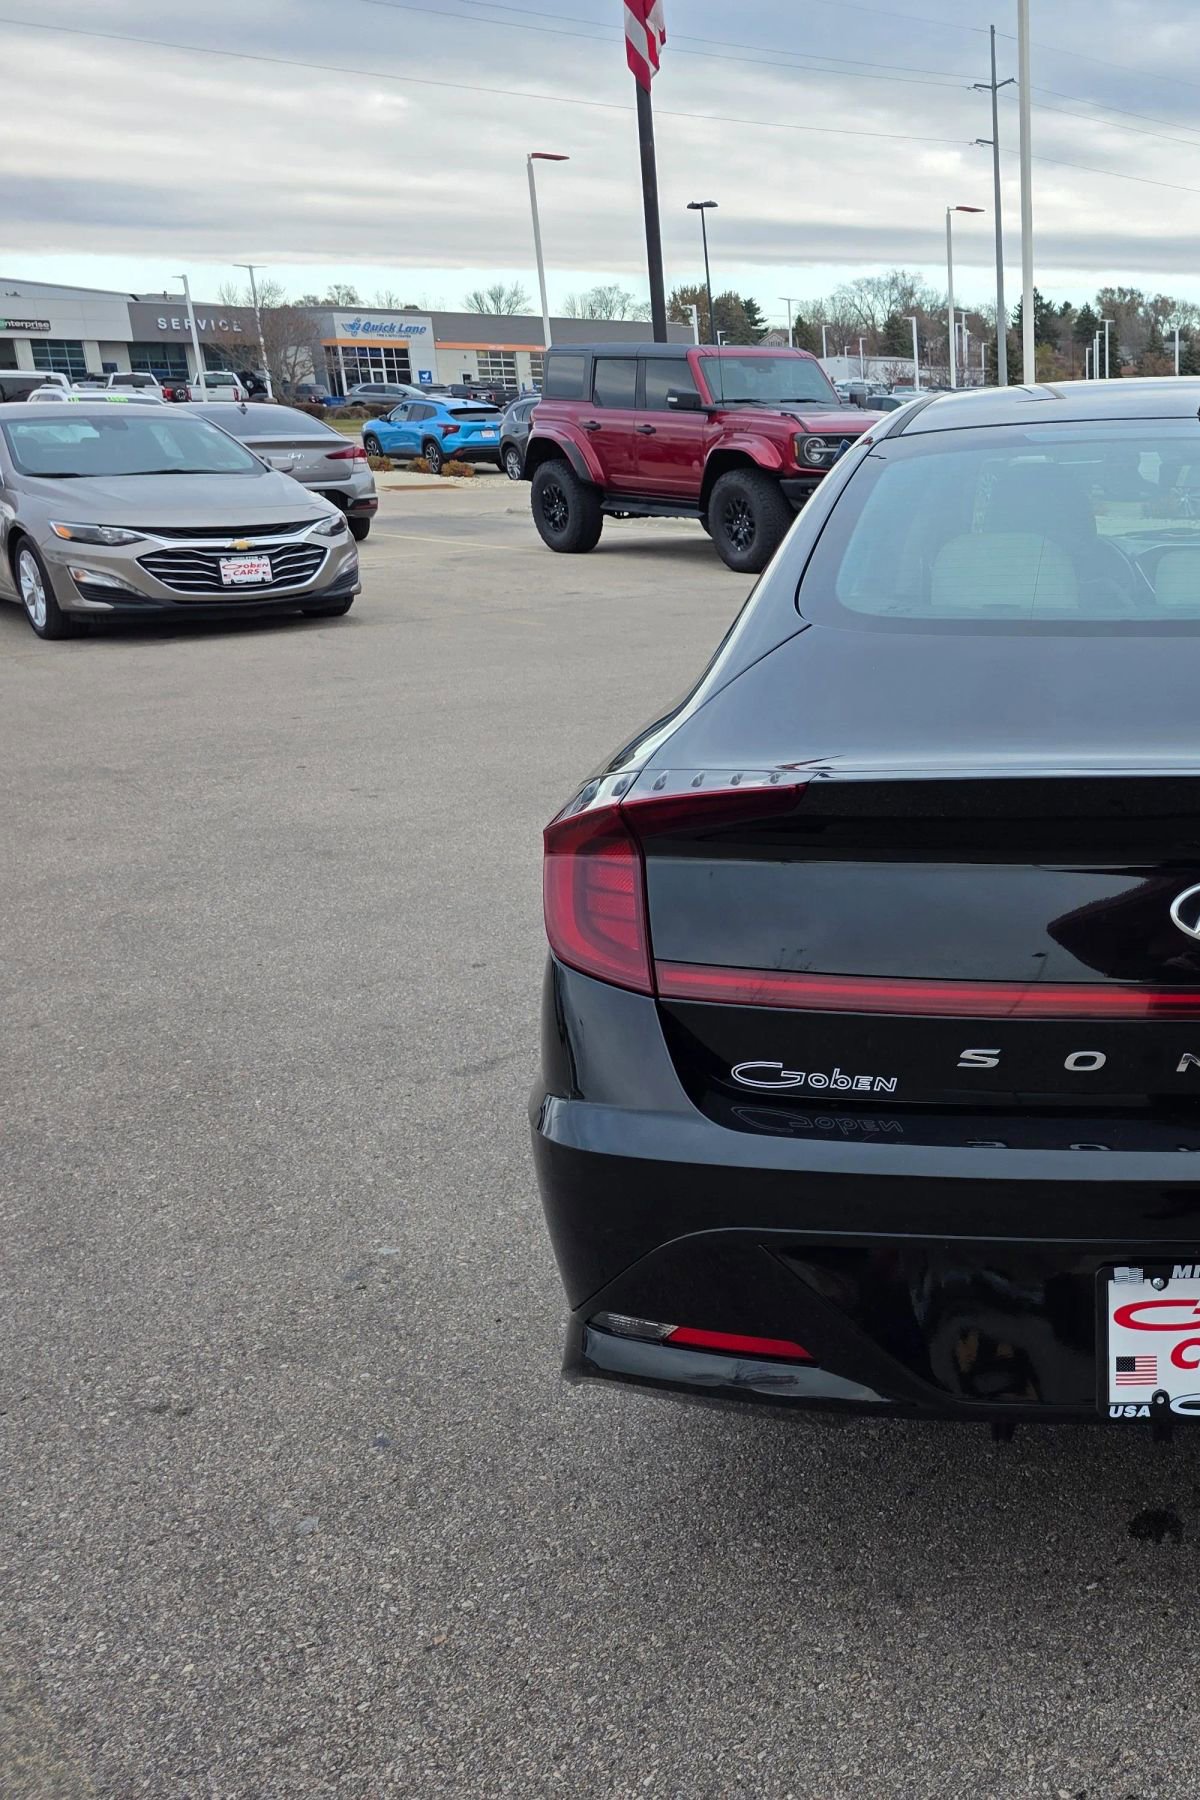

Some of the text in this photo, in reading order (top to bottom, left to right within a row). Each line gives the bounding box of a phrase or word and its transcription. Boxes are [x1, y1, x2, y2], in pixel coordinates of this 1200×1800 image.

[0, 319, 50, 329] nterprise
[157, 317, 242, 332] SERVICE
[361, 321, 427, 335] Quick Lane
[1109, 1405, 1151, 1418] USA
